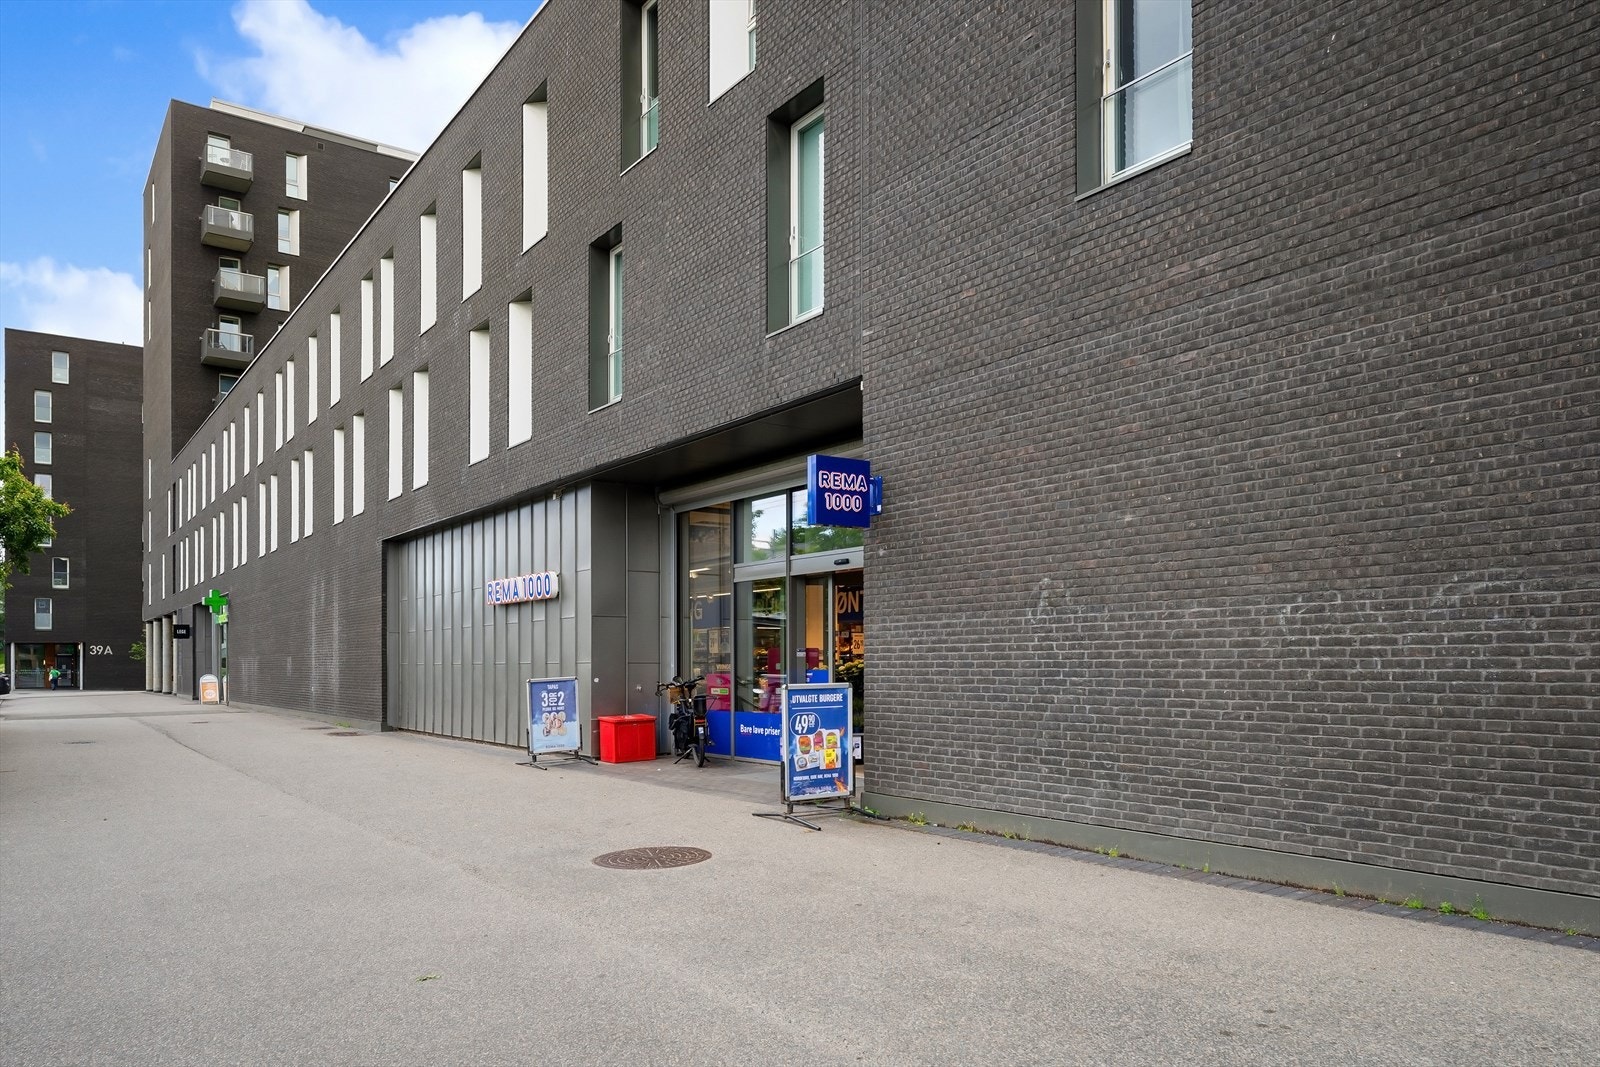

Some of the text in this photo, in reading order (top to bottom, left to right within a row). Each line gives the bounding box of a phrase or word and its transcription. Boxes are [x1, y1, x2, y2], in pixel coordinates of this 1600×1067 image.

[819, 470, 868, 492] REMA
[825, 492, 863, 513] 1000
[487, 573, 551, 604] REMA 1000
[541, 691, 565, 707] 3 FOR 2
[791, 693, 843, 703] UTVALGTE BURGERE
[740, 724, 781, 736] Bare lave priser
